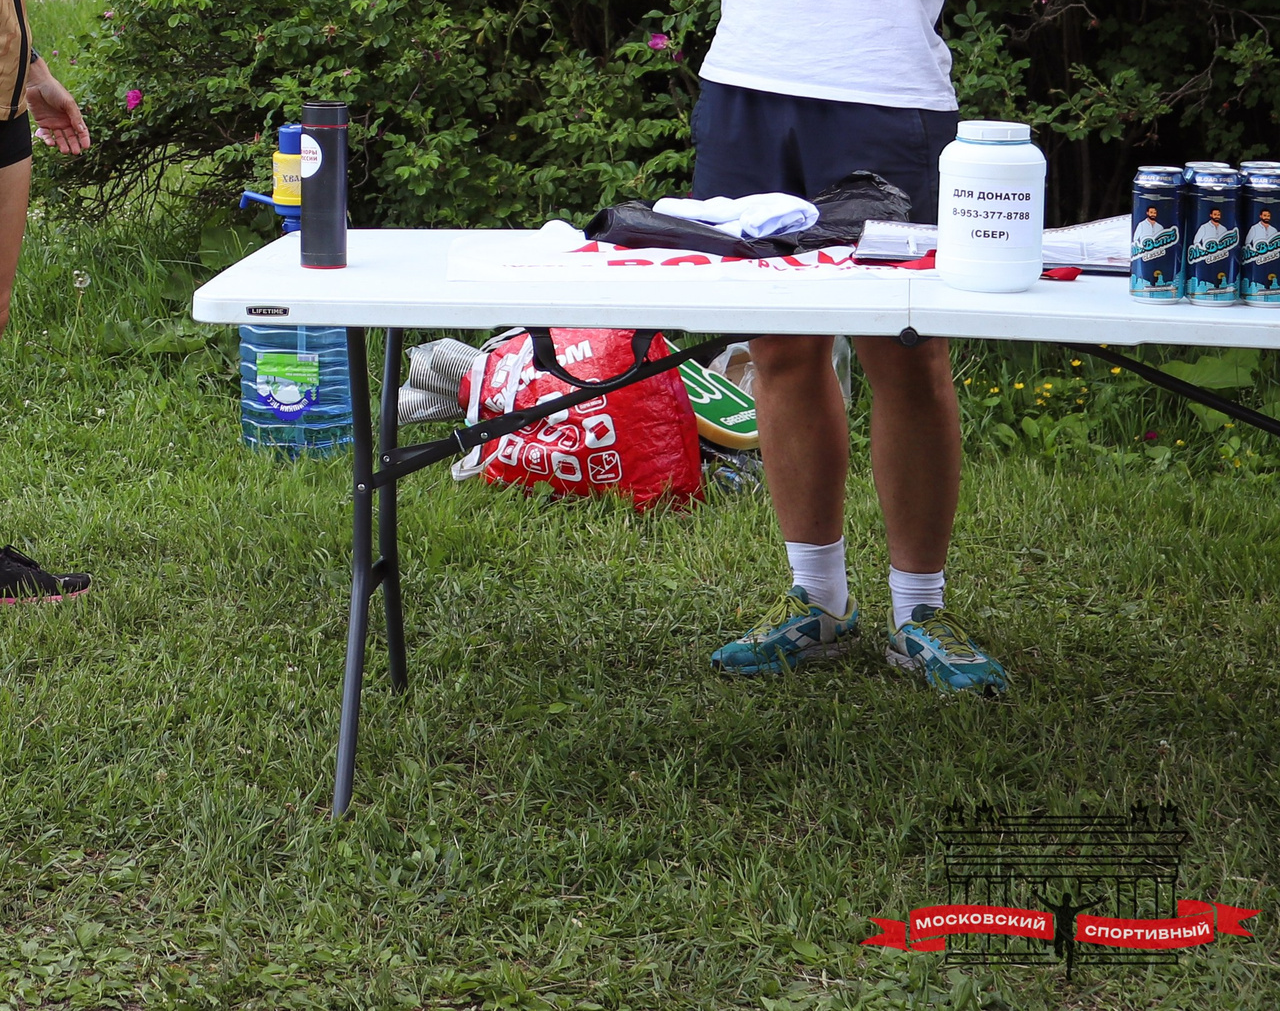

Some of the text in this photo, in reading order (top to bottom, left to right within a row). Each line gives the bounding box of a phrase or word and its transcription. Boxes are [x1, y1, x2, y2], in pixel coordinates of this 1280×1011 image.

[282, 174, 301, 183] ХВА
[953, 188, 1031, 201] ДЛЯ ДОНАТОВ
[952, 207, 1030, 221] 8-953-377-8788
[971, 229, 1010, 241] (СБЕР)
